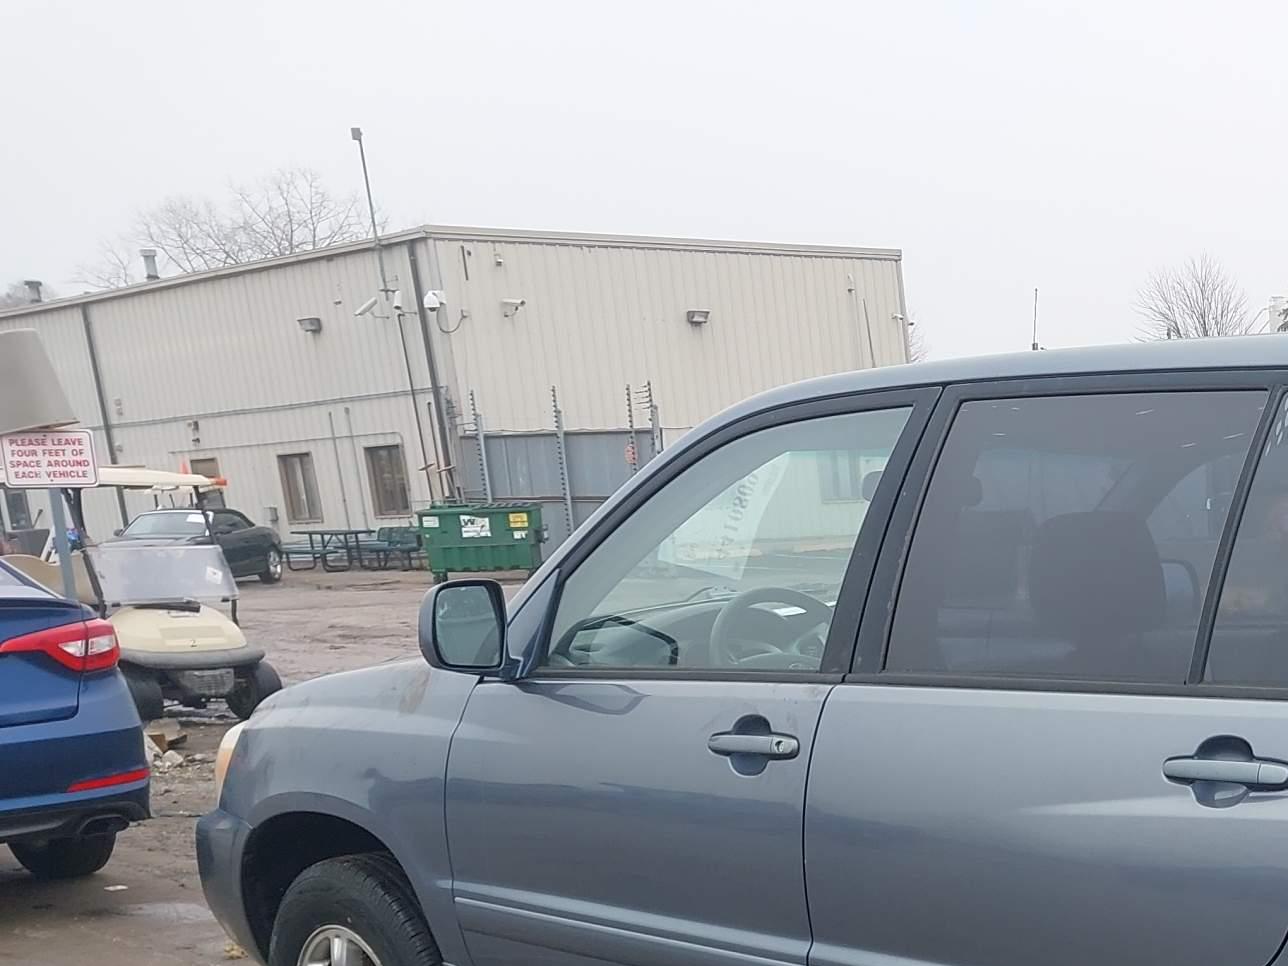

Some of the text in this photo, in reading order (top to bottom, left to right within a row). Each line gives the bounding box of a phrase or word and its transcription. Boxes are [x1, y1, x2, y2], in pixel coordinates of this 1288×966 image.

[8, 438, 84, 447] PLEASE LEAVE
[11, 449, 84, 457] FOUR FEET OF
[9, 459, 90, 468] SPACE AROUND
[14, 470, 89, 479] EACH VEHICLE
[190, 639, 197, 648] 2
